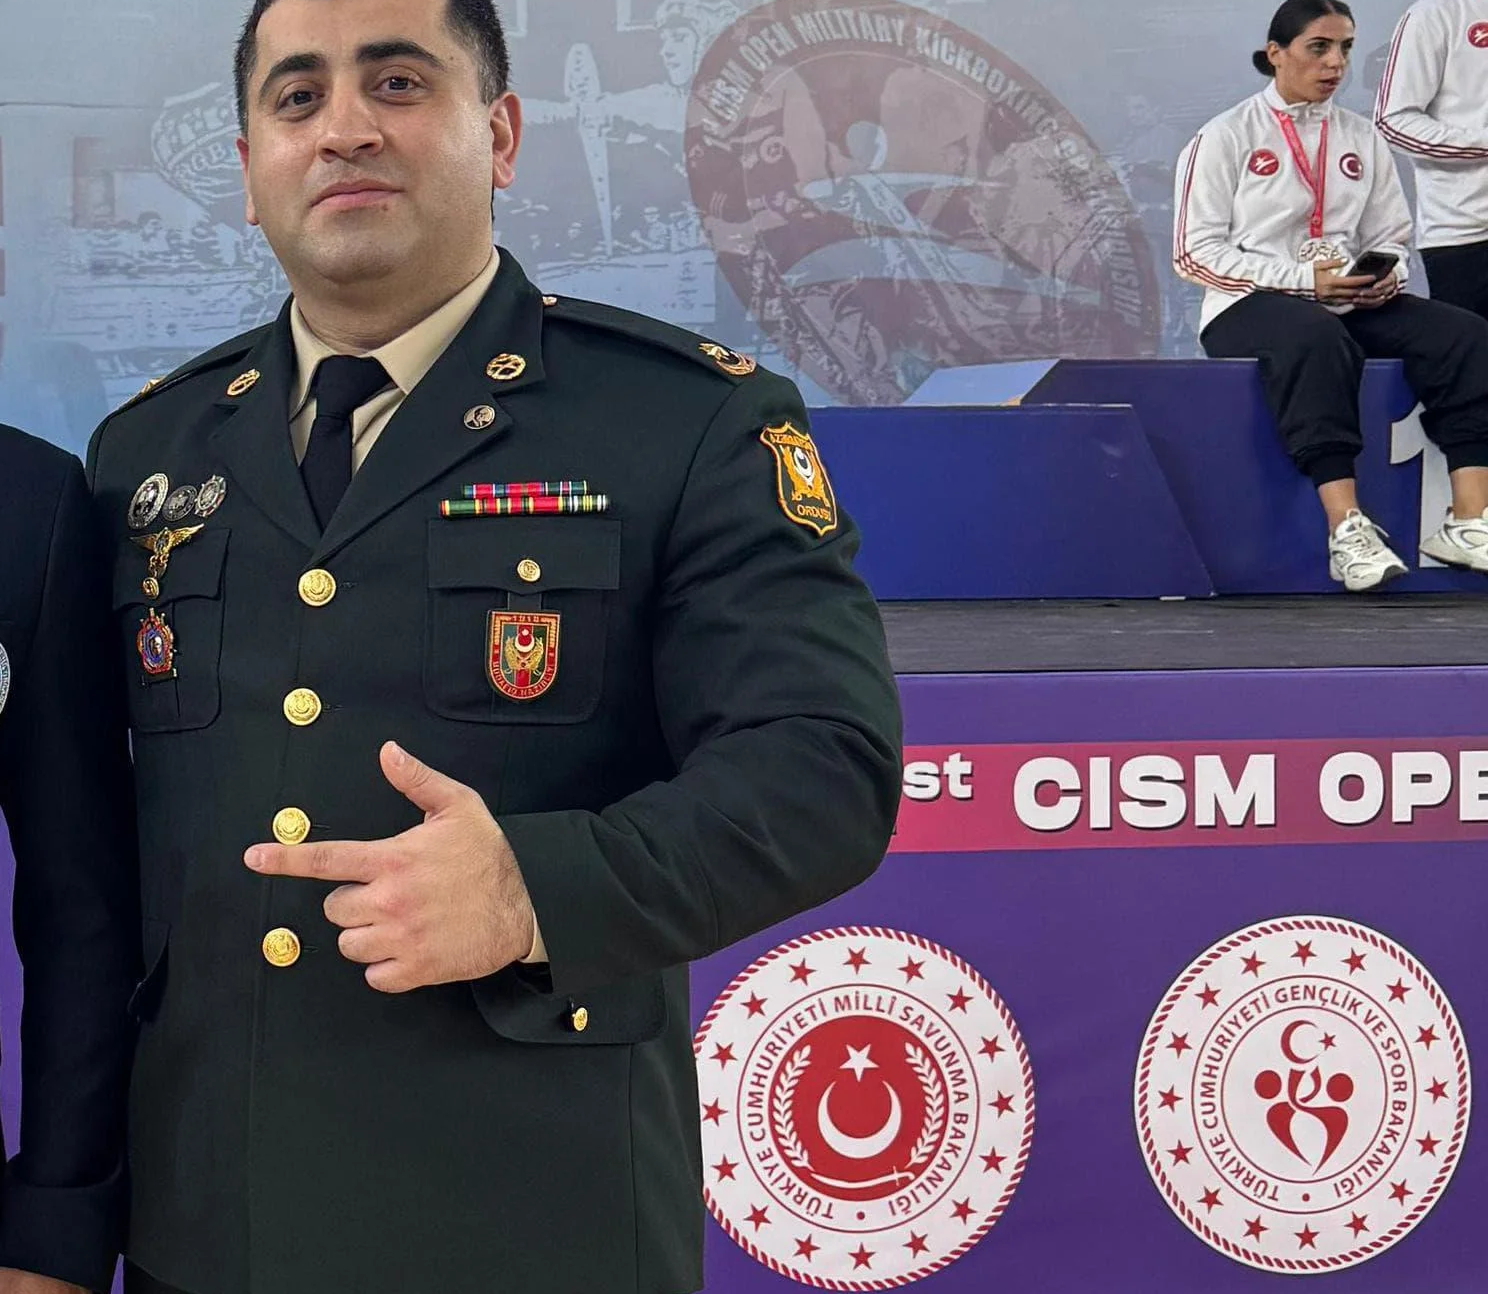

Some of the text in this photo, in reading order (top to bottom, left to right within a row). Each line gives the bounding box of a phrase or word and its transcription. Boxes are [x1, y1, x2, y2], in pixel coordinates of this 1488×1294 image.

[739, 21, 798, 71] OPEN
[791, 8, 905, 46] MILITARY
[915, 24, 1059, 136] KICKBOXING
[1390, 401, 1453, 569] 1
[902, 752, 973, 801] st
[1013, 753, 1276, 831] CISM
[747, 996, 827, 1142] CUMHURİYETİ
[899, 1005, 969, 1103] SAVUNMA
[1199, 985, 1408, 1202] TÜRKİYE CUMHURİYETİ GENÇLİK VE SPOR BAKANLIĞI
[756, 1146, 834, 1220] TÜRKİYE
[889, 1112, 969, 1217] BAKANLIĞI
